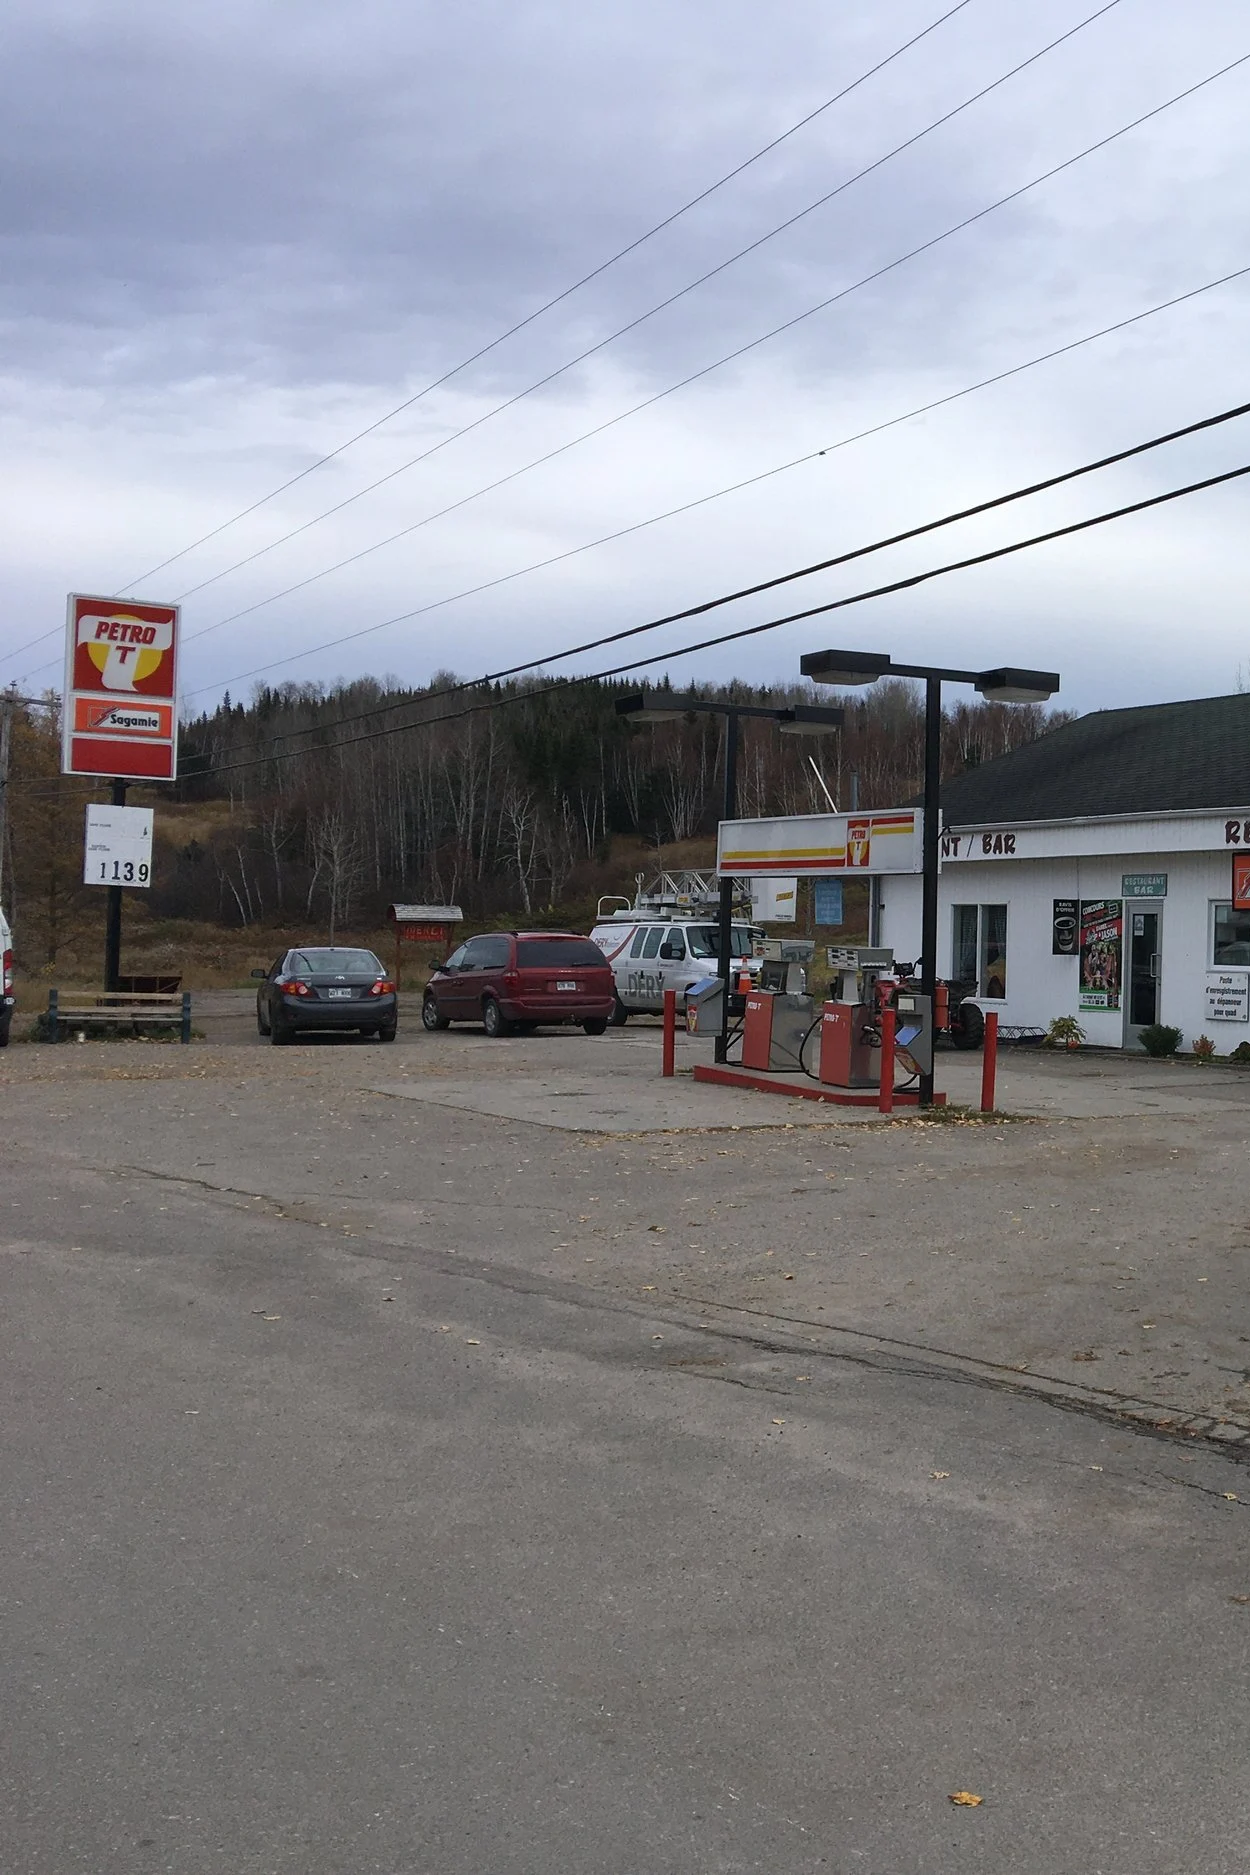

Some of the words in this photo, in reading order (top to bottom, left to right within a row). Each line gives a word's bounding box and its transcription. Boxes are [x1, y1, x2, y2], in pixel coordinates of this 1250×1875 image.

[95, 621, 157, 645] PETRO
[115, 645, 137, 665] T
[110, 713, 159, 728] Sagamie
[982, 833, 1016, 855] BAR
[1134, 886, 1154, 895] BAR
